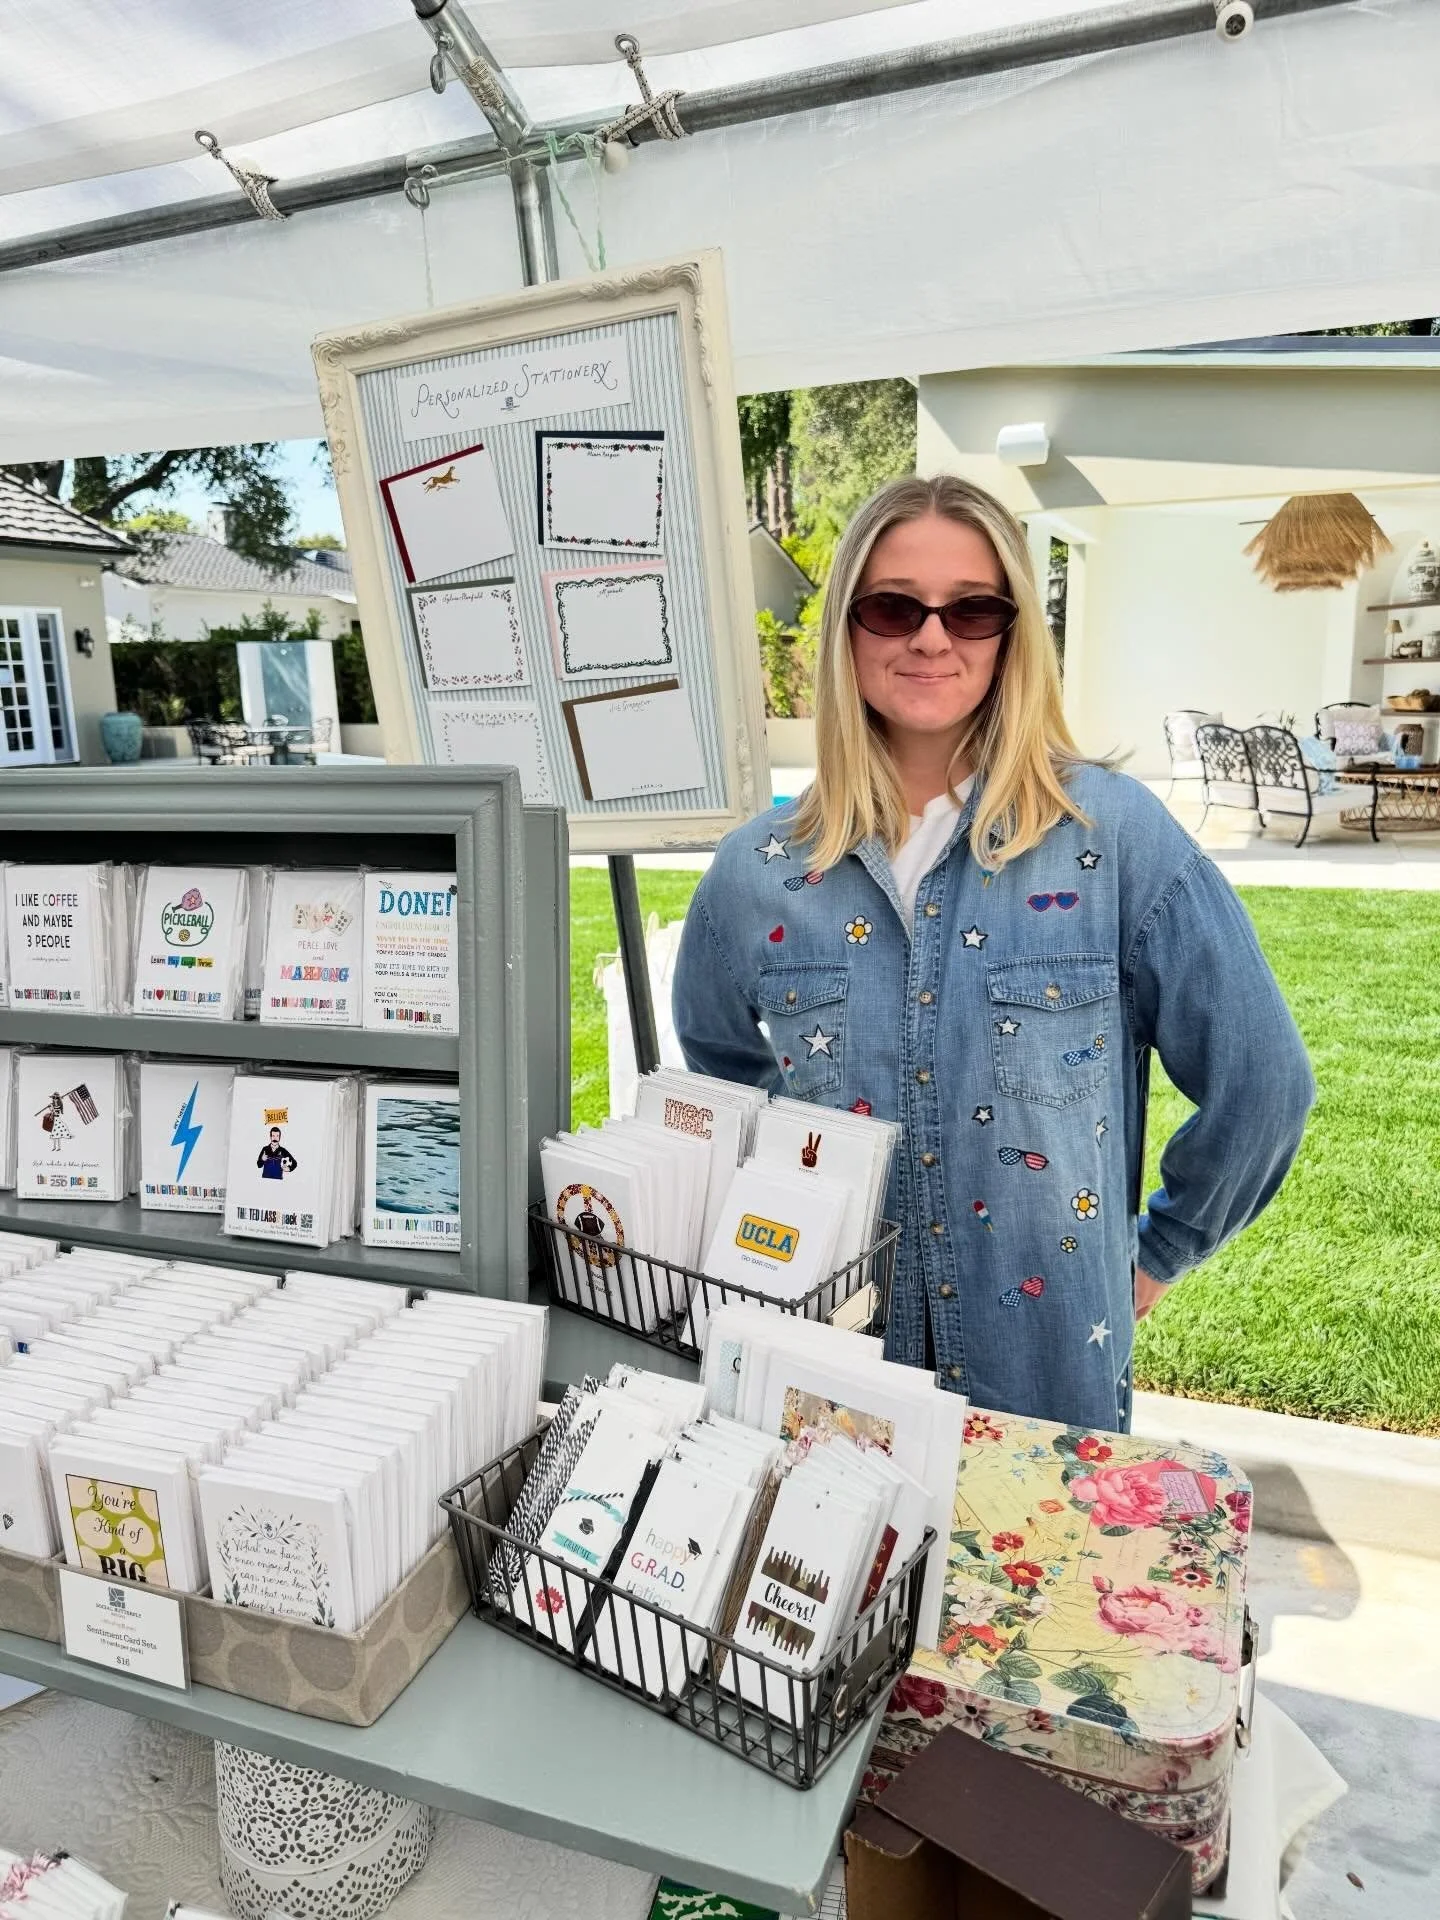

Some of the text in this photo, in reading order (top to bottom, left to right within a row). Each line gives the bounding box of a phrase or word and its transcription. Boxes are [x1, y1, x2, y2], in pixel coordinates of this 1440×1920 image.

[411, 360, 618, 419] PERSONALIZED STATIONERY
[15, 893, 78, 907] I LIKE COFFEE
[379, 890, 452, 917] DONE!
[22, 914, 73, 928] AND MAYBE
[164, 912, 209, 928] PICKLEBALL
[27, 935, 71, 948] 3 PEOPLE
[298, 940, 338, 951] PEACE LOVE
[151, 955, 165, 964] Learn
[15, 989, 23, 999] the
[24, 989, 40, 1000] COFFEE
[271, 996, 280, 1008] the
[383, 1008, 431, 1023] the GRAD pack
[266, 1111, 288, 1122] BELIEVE
[664, 1097, 714, 1139] USC
[146, 1184, 156, 1194] the
[204, 1187, 218, 1198] pack
[237, 1206, 249, 1219] THE
[249, 1208, 260, 1221] TED
[282, 1212, 297, 1226] pack
[420, 1220, 444, 1232] WATER
[742, 1221, 794, 1254] UCLA
[741, 1254, 751, 1262] GO
[88, 1486, 136, 1511] You're
[94, 1517, 143, 1544] Kind of
[232, 1538, 259, 1552] What
[264, 1547, 277, 1556] we
[563, 1538, 591, 1561] GRADUATE
[646, 1528, 692, 1565] happy
[631, 1552, 685, 1592] G.R.A.D.
[242, 1583, 258, 1594] All
[261, 1587, 278, 1599] that
[626, 1580, 671, 1610] uation
[764, 1582, 816, 1623] Cheers!
[86, 1624, 122, 1641] Sentiment
[123, 1634, 141, 1646] Card
[141, 1639, 157, 1650] Sets
[116, 1656, 130, 1666] $16
